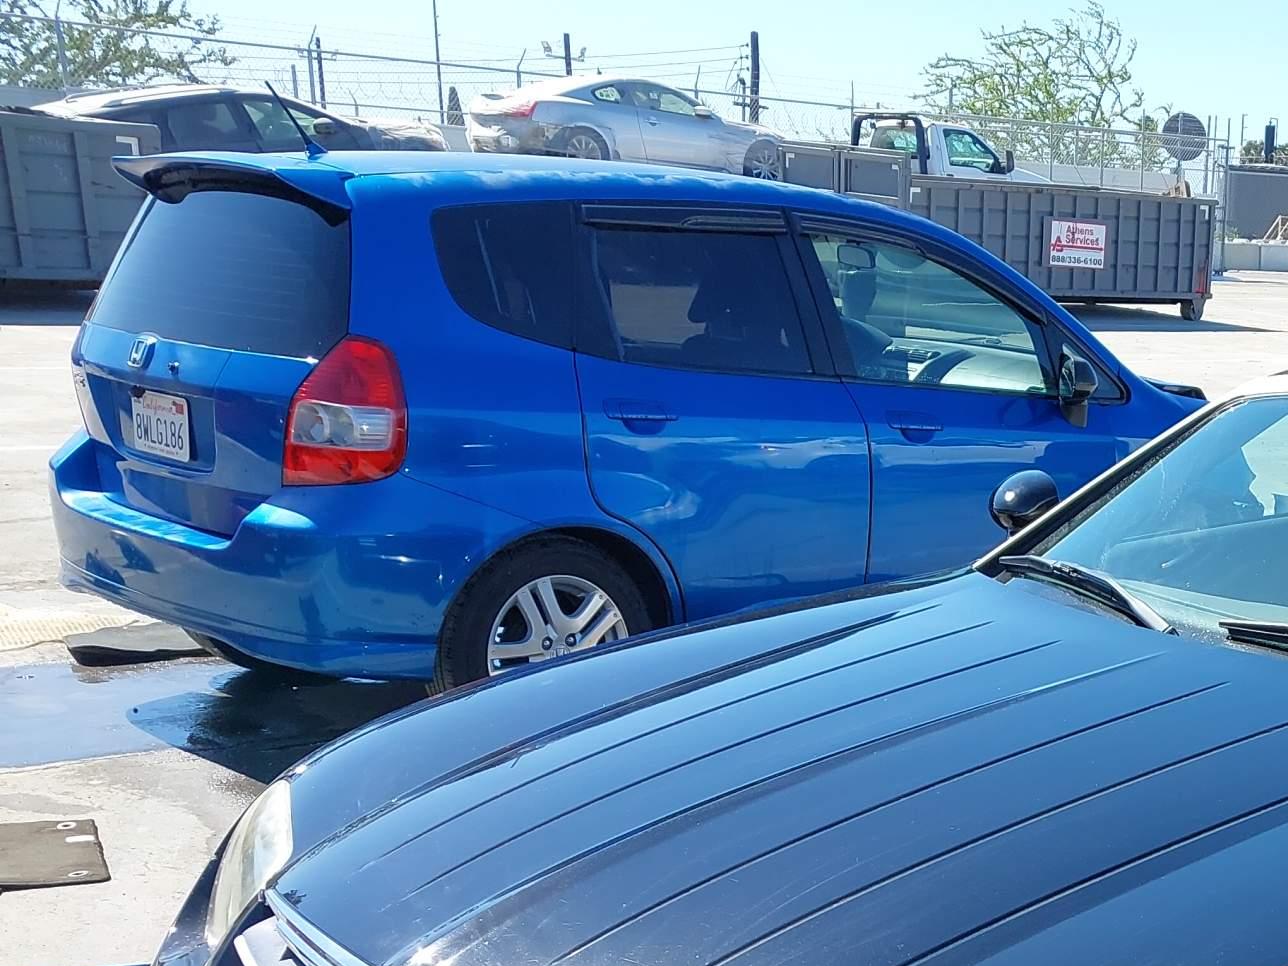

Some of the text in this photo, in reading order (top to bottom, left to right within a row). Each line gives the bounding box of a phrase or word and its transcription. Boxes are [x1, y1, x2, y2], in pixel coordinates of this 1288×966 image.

[1066, 223, 1094, 236] Athens
[1065, 233, 1100, 247] Services
[1051, 254, 1103, 266] 888/336-6100
[135, 412, 184, 450] 8WLG186
